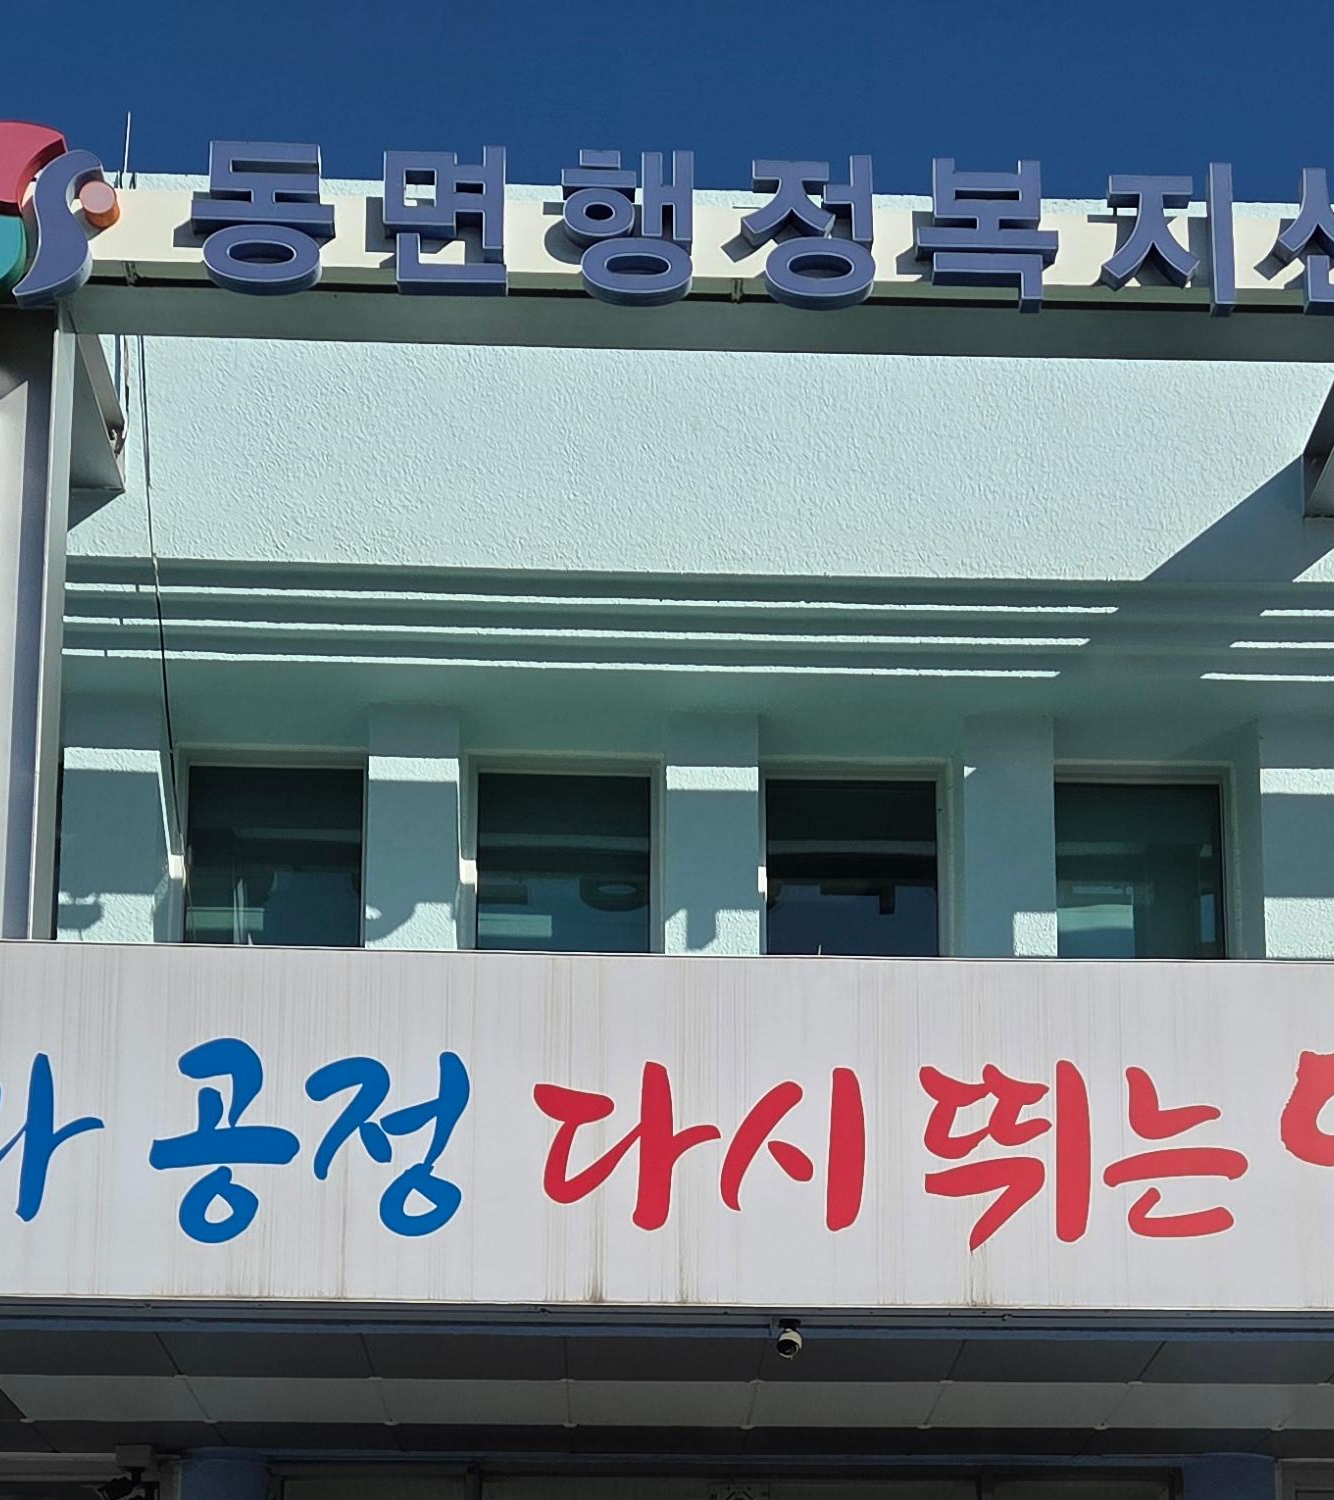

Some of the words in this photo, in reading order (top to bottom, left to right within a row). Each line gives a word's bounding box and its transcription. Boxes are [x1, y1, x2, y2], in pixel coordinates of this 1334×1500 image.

[150, 1039, 470, 1244] 공정
[534, 1062, 864, 1231] 다시
[920, 1061, 1247, 1248] 뛰는
